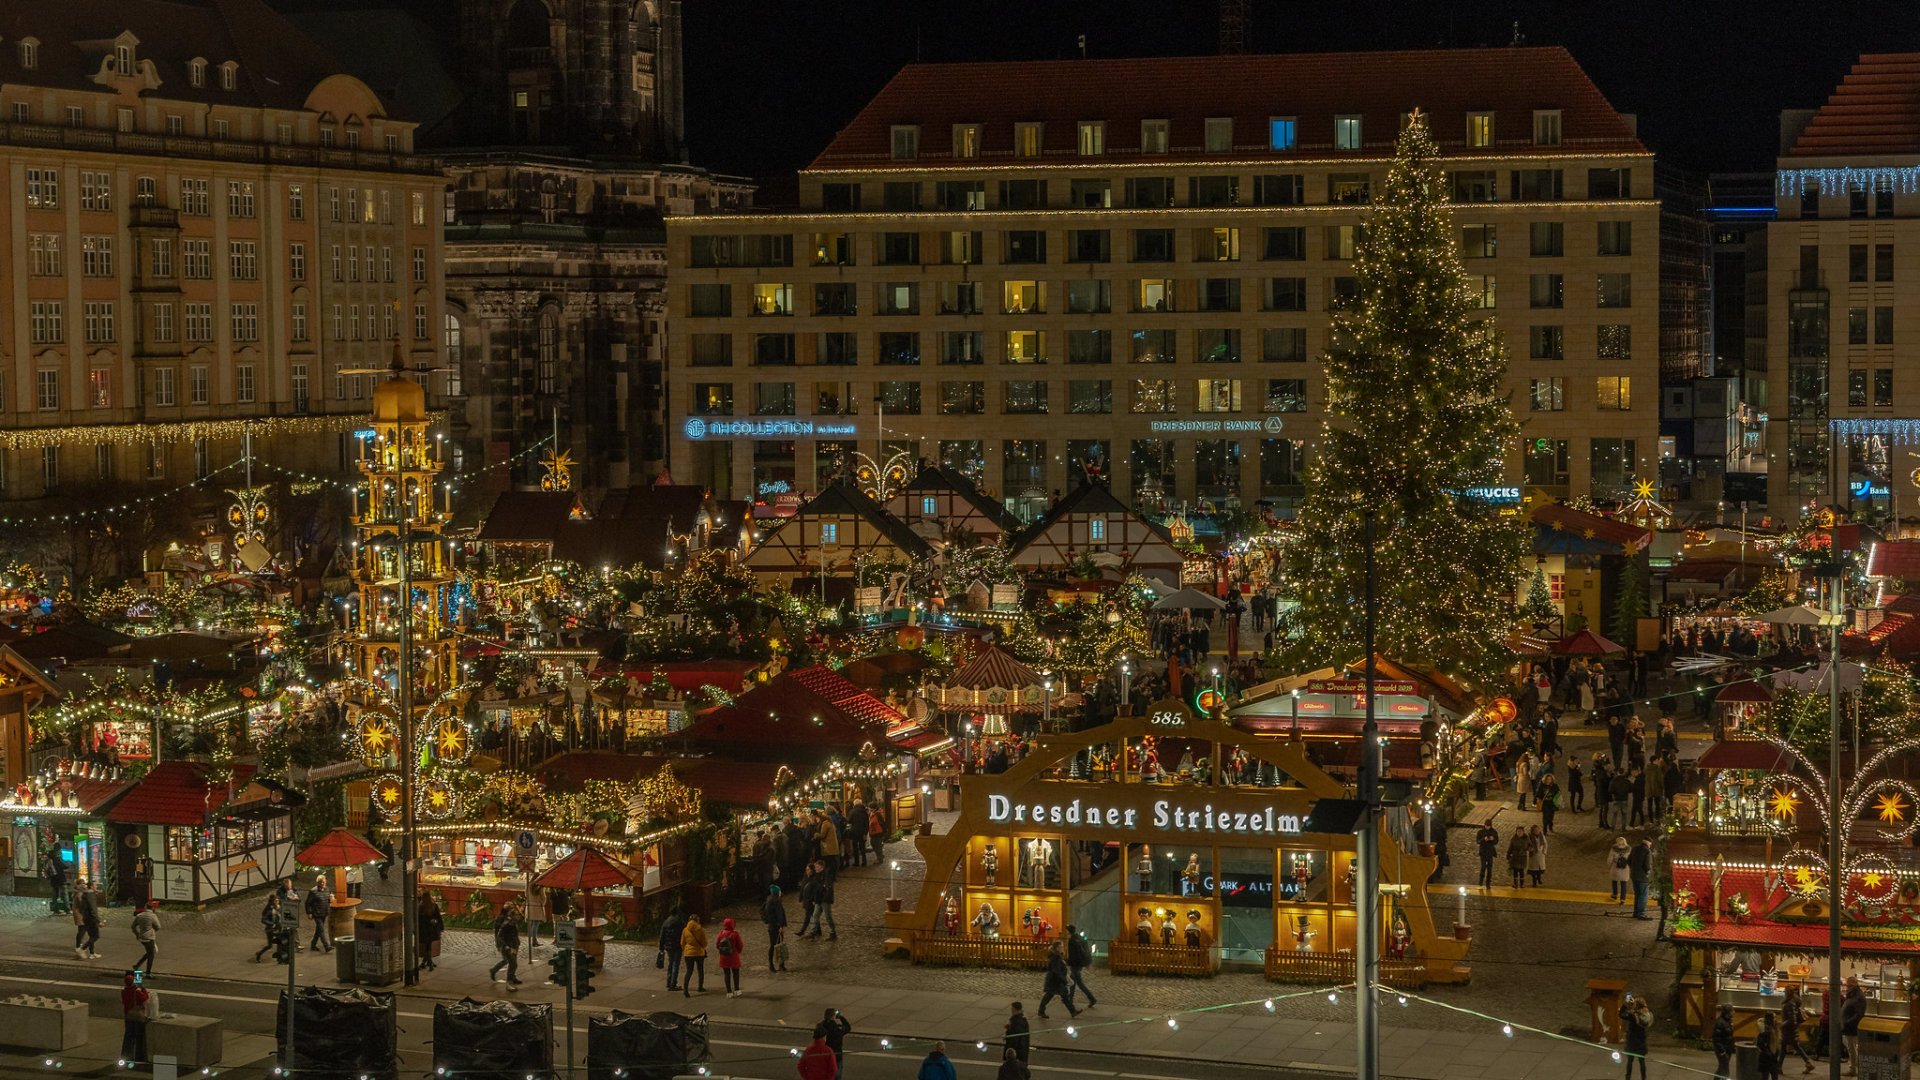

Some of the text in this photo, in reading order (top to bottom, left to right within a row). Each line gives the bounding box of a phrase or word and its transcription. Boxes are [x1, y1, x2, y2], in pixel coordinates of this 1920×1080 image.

[731, 421, 813, 434] COLLECTION
[1151, 421, 1262, 431] DRESDNER BANK
[1850, 482, 1862, 490] BB
[1150, 711, 1185, 725] 585.
[988, 794, 1136, 827] Dresdner
